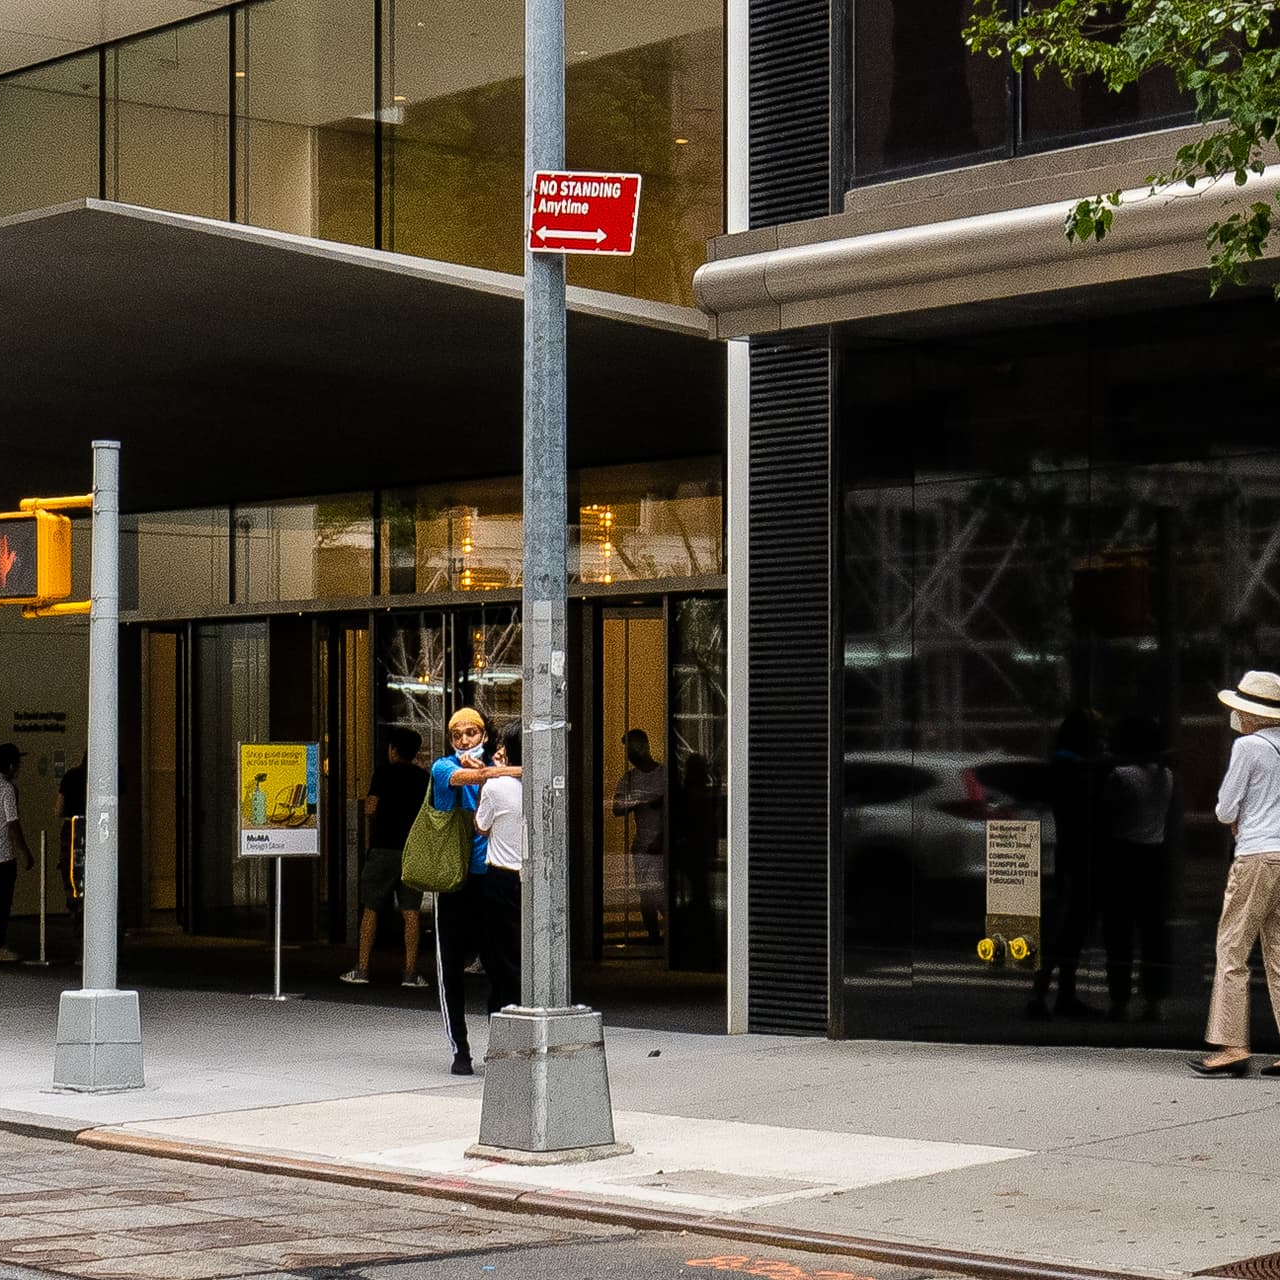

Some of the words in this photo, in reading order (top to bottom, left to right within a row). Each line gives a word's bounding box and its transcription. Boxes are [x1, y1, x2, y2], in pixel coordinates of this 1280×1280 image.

[539, 180, 558, 196] NO
[559, 181, 621, 198] STANDING
[538, 198, 590, 216] Anytime
